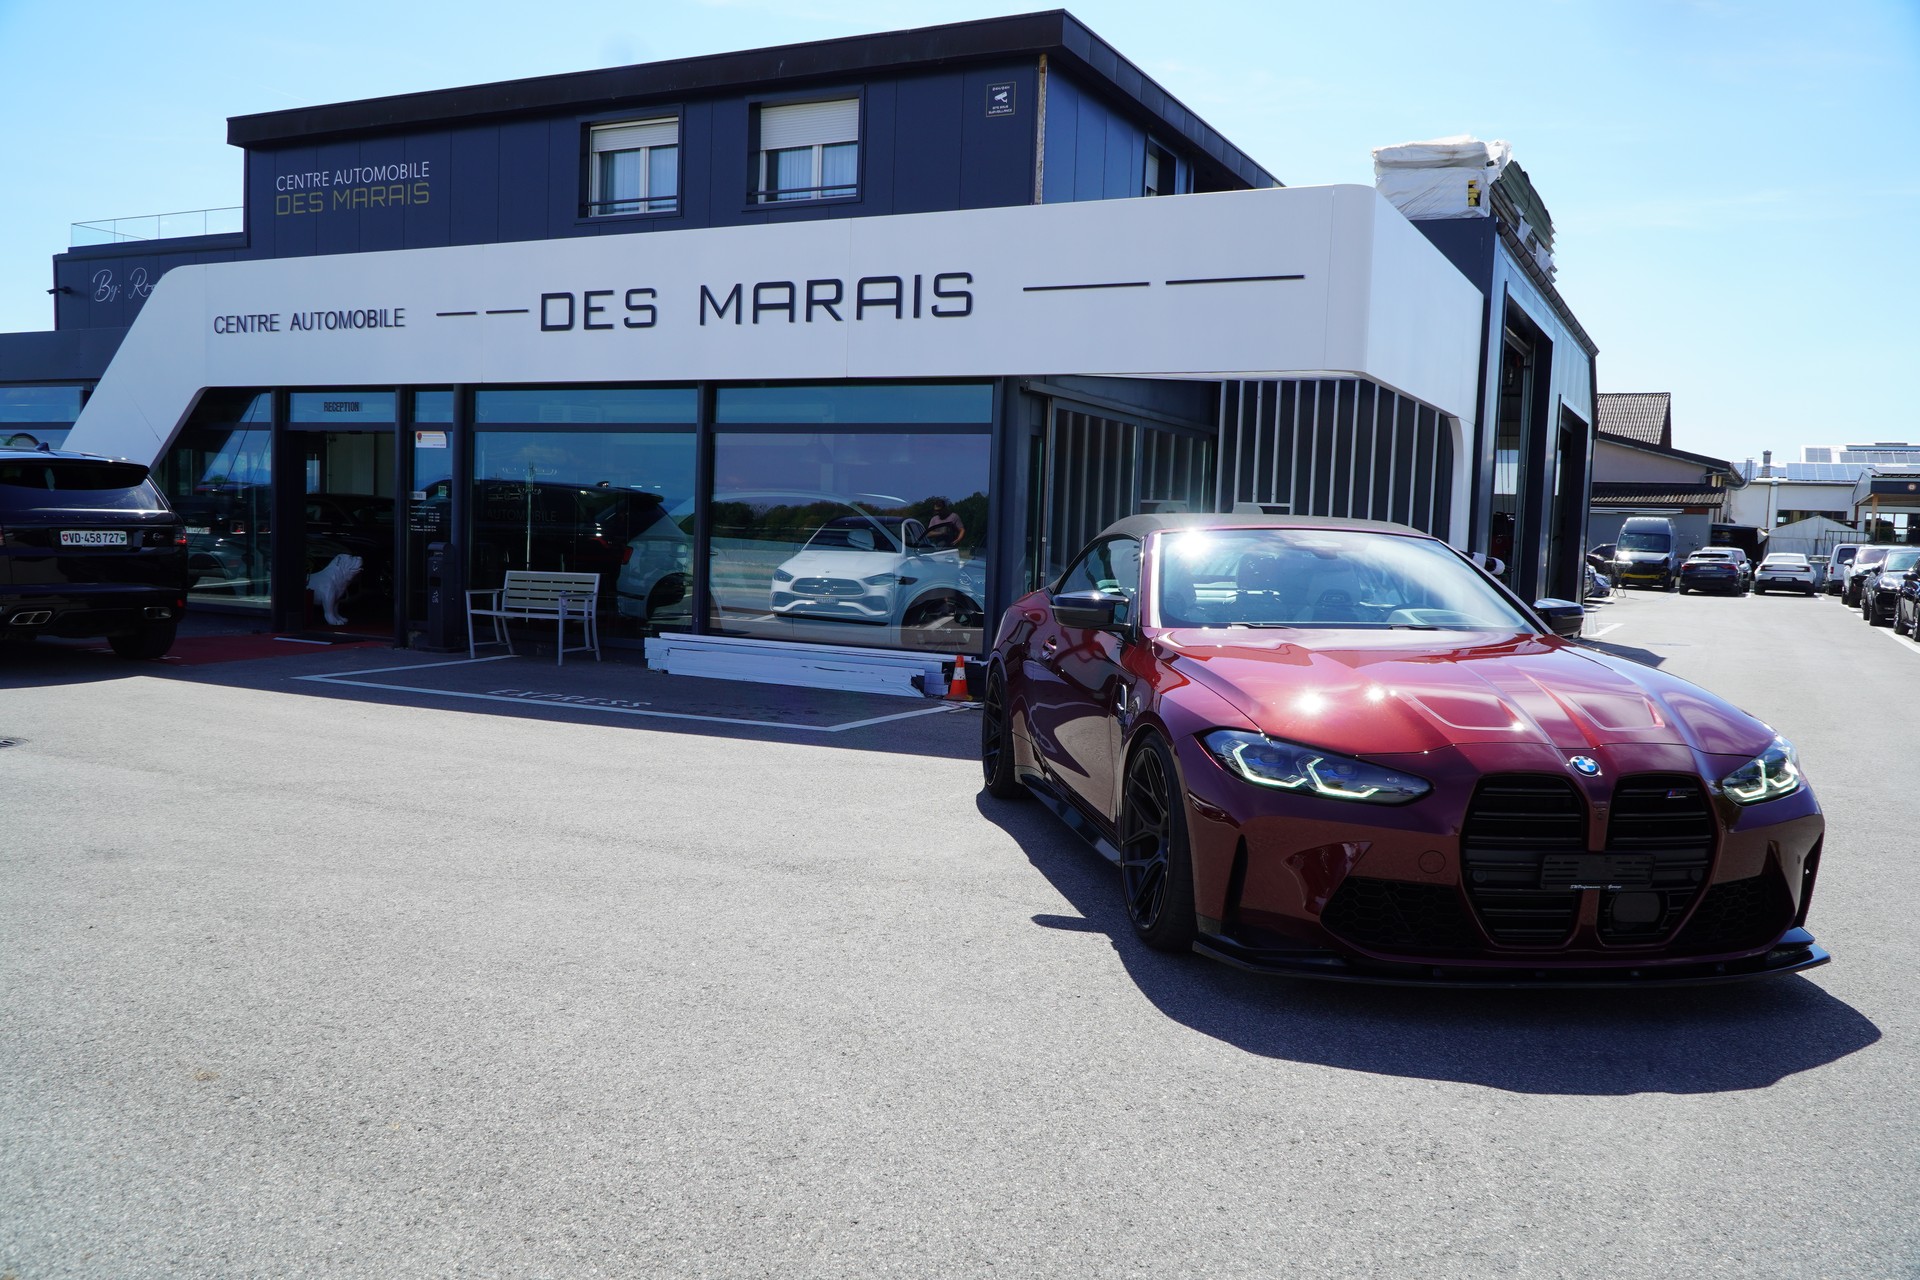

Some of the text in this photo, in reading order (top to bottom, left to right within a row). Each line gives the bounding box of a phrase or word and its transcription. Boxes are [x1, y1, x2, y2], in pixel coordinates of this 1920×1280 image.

[276, 161, 430, 191] CENTRE AUTOMOBILE
[276, 182, 430, 215] DES MARAIS
[213, 271, 974, 334] CENTRE AUTOMOBILE DES MARAIS
[323, 401, 360, 412] RECEPTION
[486, 688, 652, 708] EXPRESS
